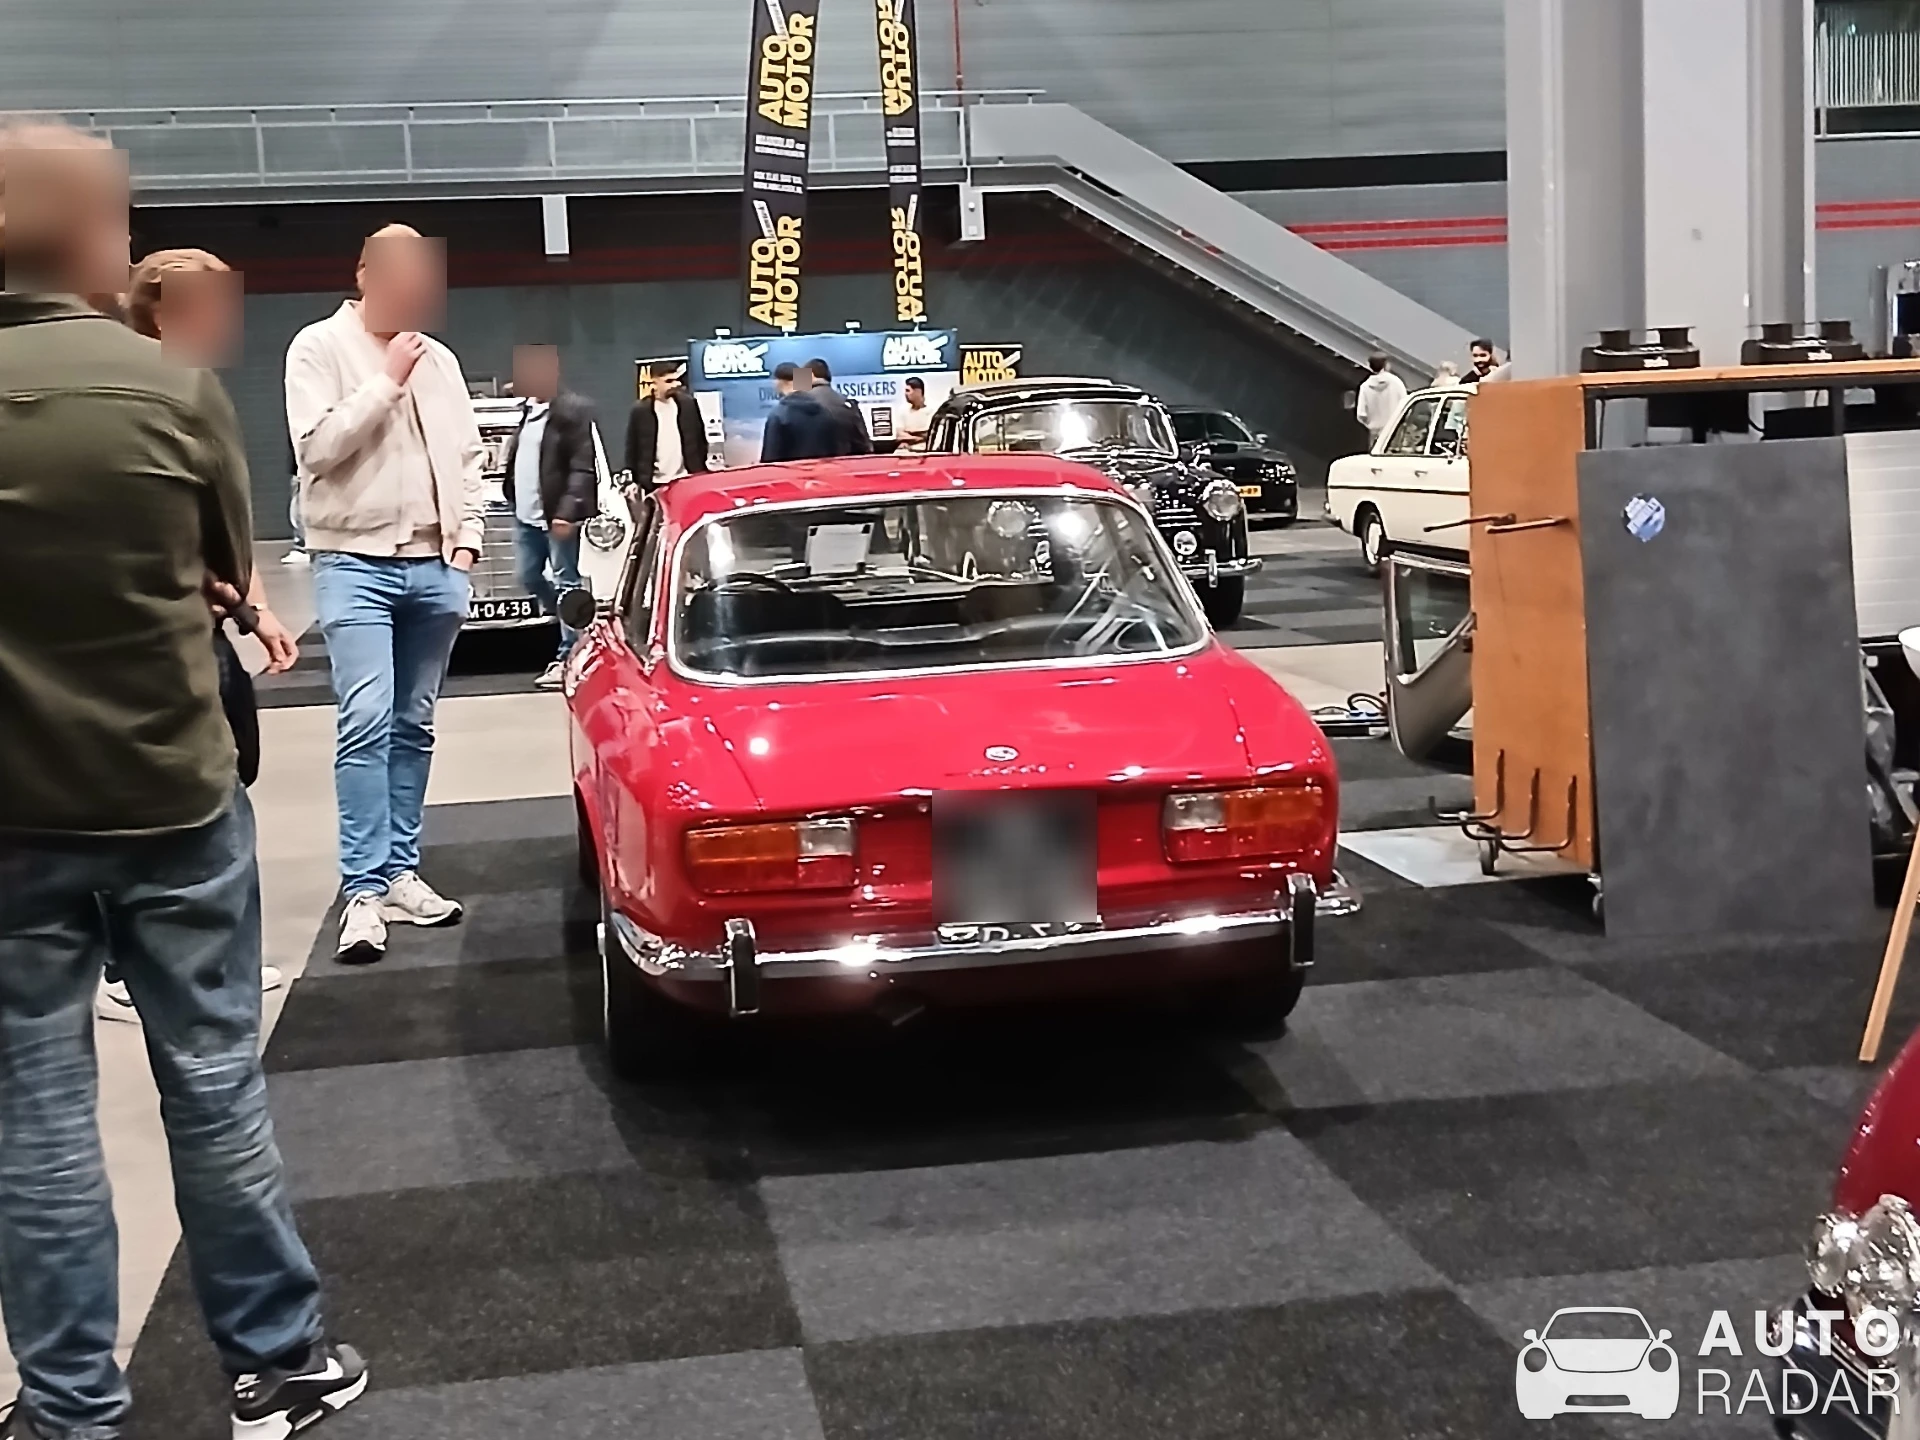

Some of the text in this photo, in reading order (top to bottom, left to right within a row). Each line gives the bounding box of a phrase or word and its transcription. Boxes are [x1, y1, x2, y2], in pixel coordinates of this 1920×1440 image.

[758, 34, 788, 124] AUTO
[783, 13, 814, 128] MOTOR
[749, 238, 776, 326] AUTO
[773, 215, 802, 326] MOTOR
[963, 351, 1004, 368] AUTO
